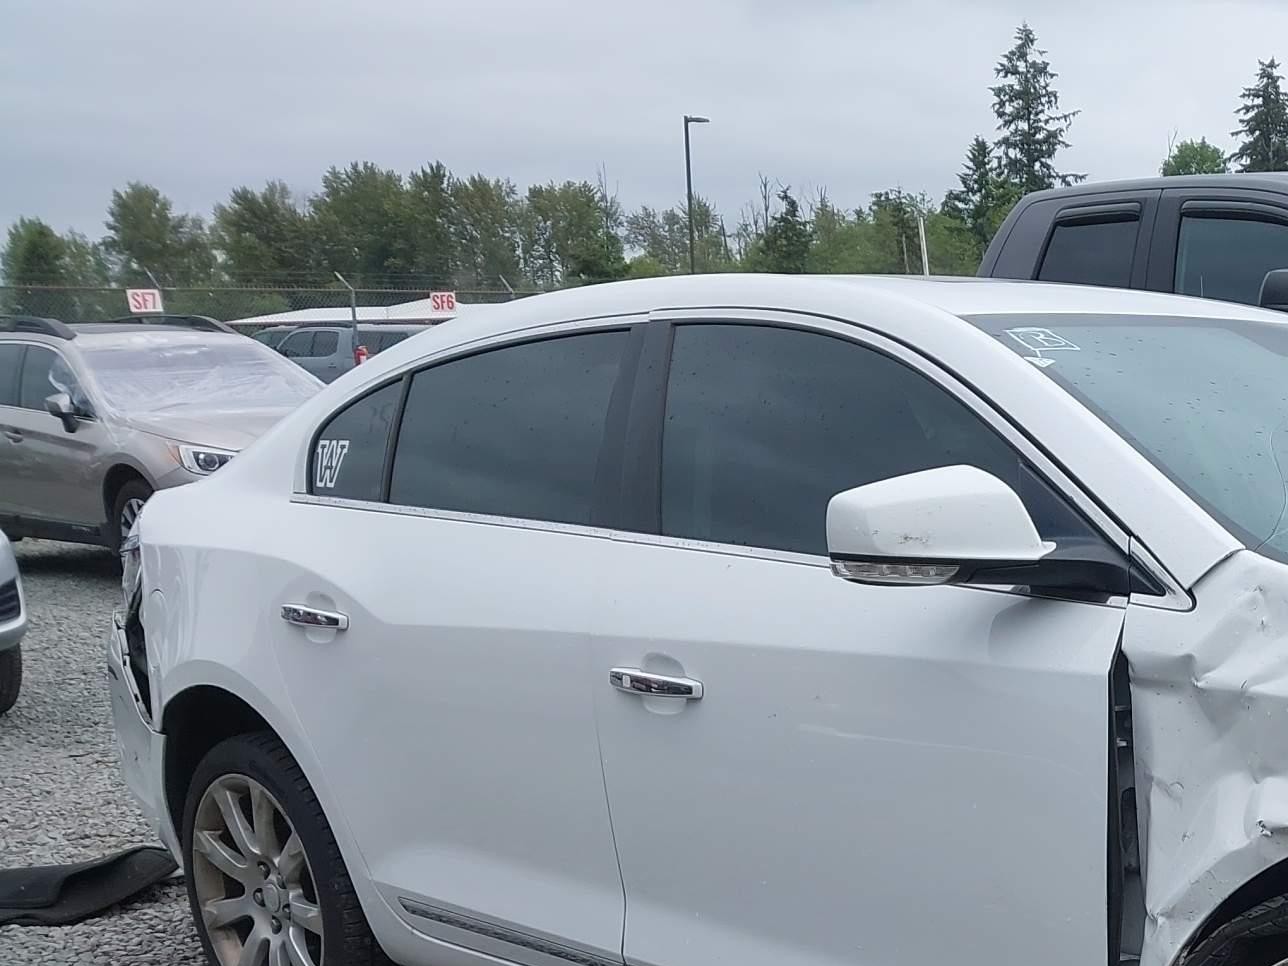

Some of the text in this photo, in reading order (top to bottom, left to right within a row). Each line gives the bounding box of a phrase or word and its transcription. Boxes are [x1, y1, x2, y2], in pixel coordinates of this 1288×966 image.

[131, 292, 157, 310] SF7
[432, 294, 454, 310] SF6
[316, 440, 350, 488] W
